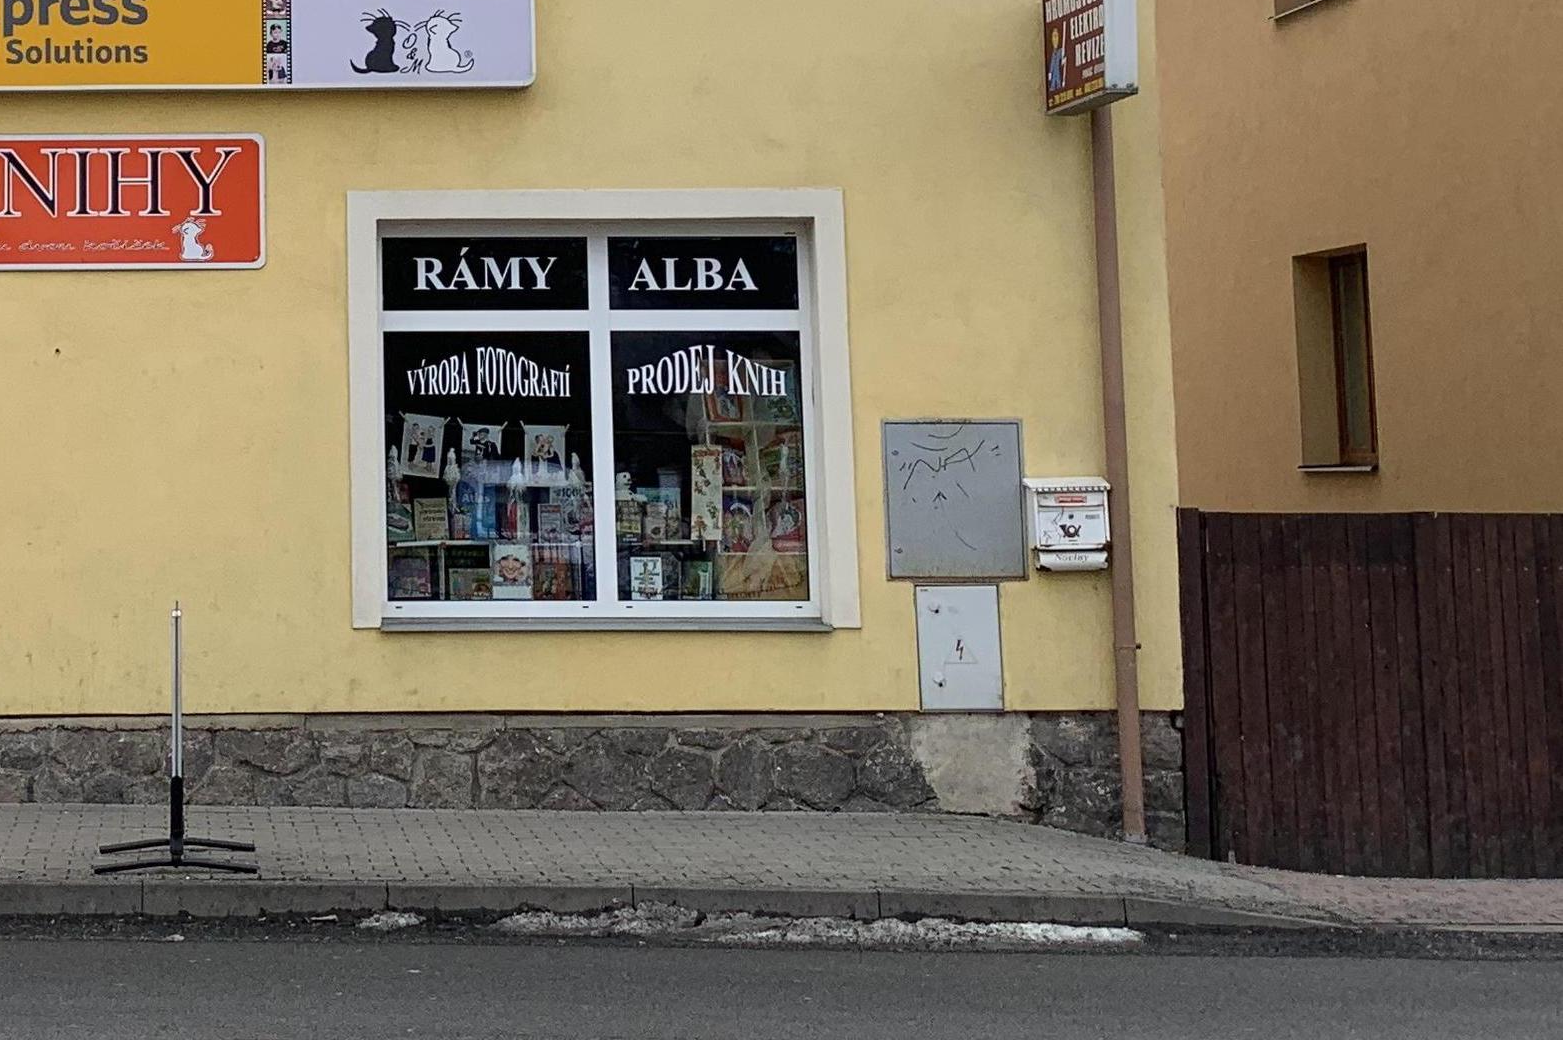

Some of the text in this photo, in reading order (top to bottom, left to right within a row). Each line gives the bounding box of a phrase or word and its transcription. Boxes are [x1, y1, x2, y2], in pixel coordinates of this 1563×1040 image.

[5, 37, 148, 65] Solutions
[1075, 33, 1105, 67] REVIZE
[413, 247, 558, 291] RÁMY
[628, 258, 759, 291] ALBA
[406, 346, 572, 398] VÝROBA FOTOGRAFIÍ
[626, 344, 788, 396] PRODEJ KNIH
